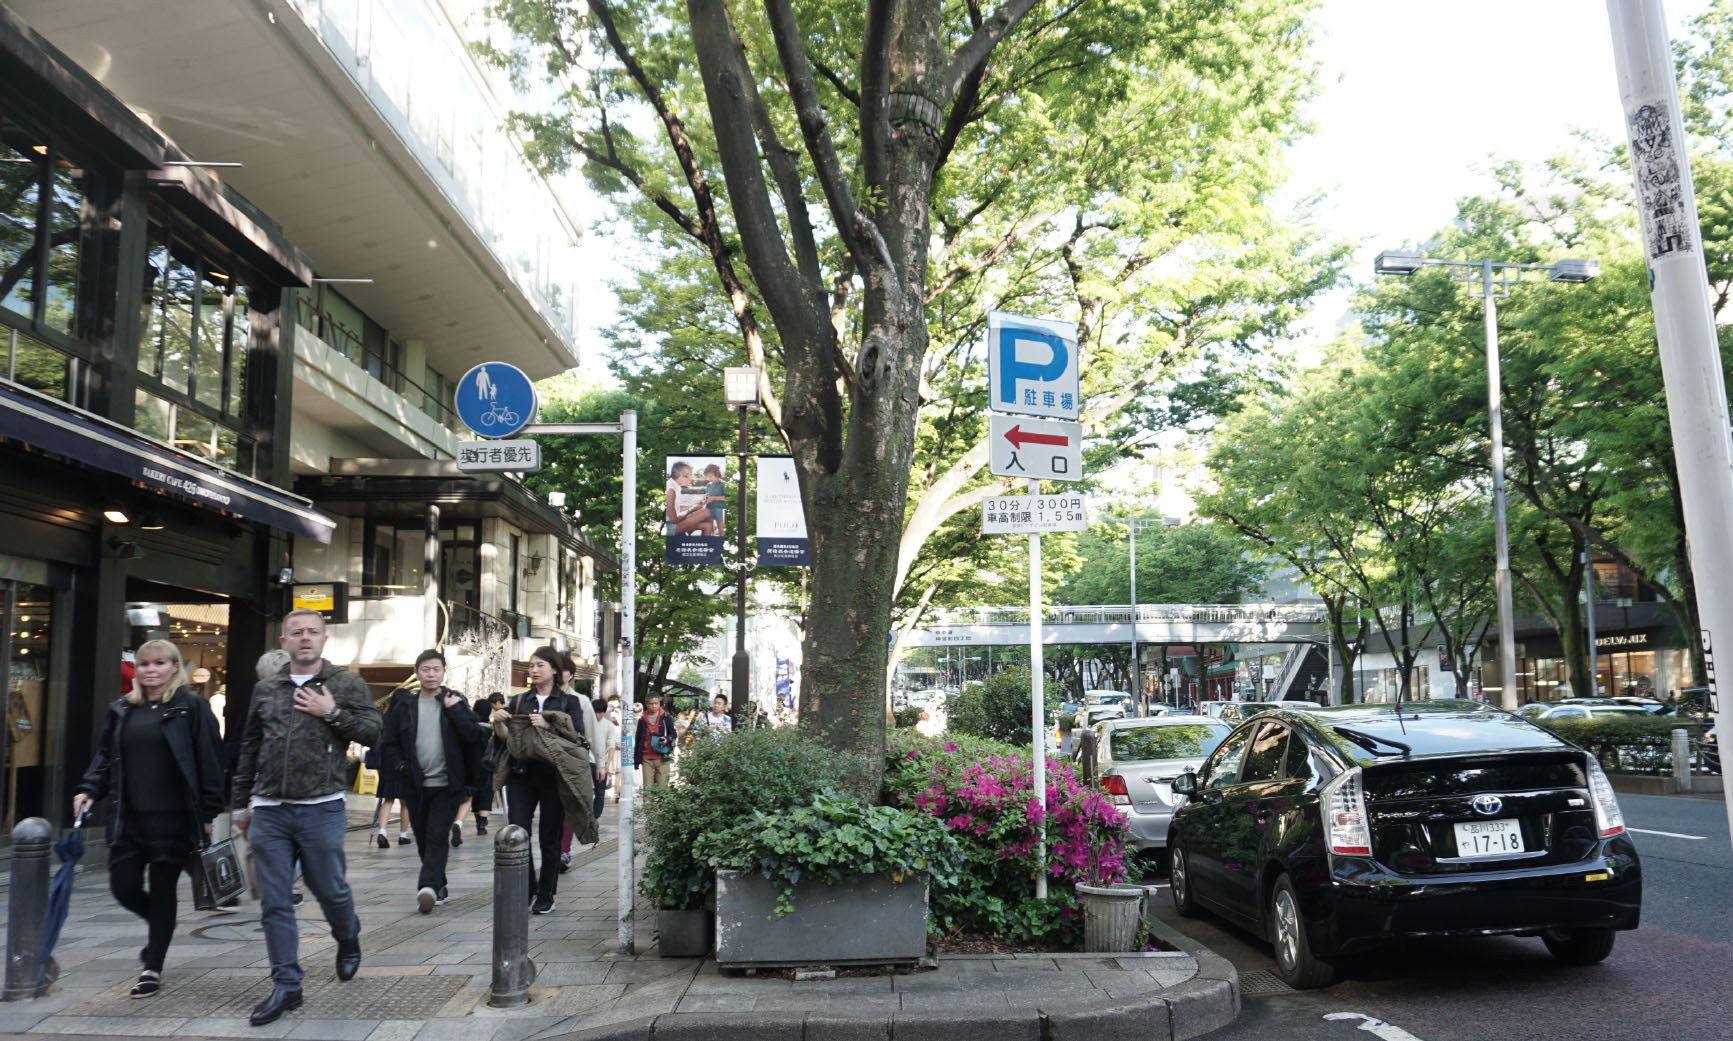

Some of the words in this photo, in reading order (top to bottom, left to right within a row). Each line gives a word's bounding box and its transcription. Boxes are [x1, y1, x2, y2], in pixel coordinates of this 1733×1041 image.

[1024, 388, 1073, 410] 駐車場
[460, 446, 532, 464] 歩行者優先
[1005, 451, 1067, 474] 入口
[987, 511, 1033, 523] 車高制限
[1473, 833, 1520, 853] 17-18
